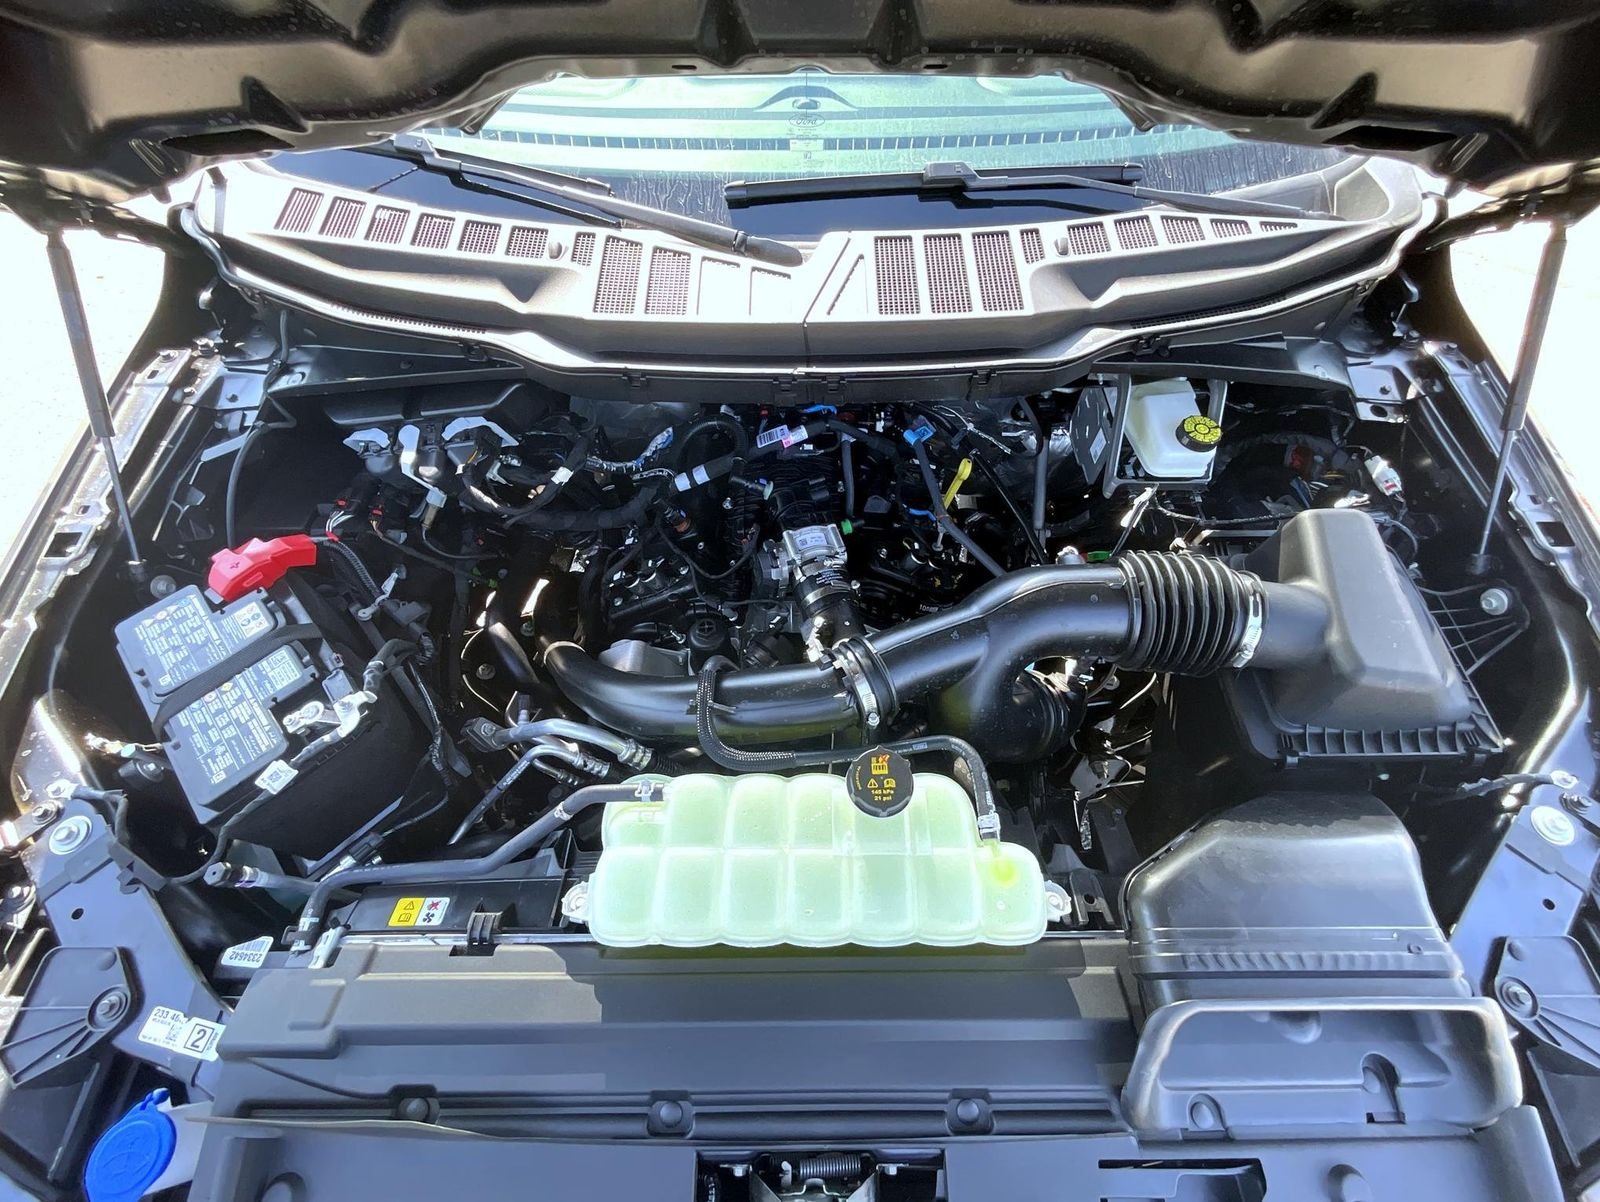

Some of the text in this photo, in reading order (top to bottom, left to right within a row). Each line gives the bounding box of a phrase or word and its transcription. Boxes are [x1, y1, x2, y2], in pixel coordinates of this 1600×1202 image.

[796, 117, 817, 125] Ford
[154, 1008, 169, 1019] 233
[190, 1028, 207, 1049] 2
